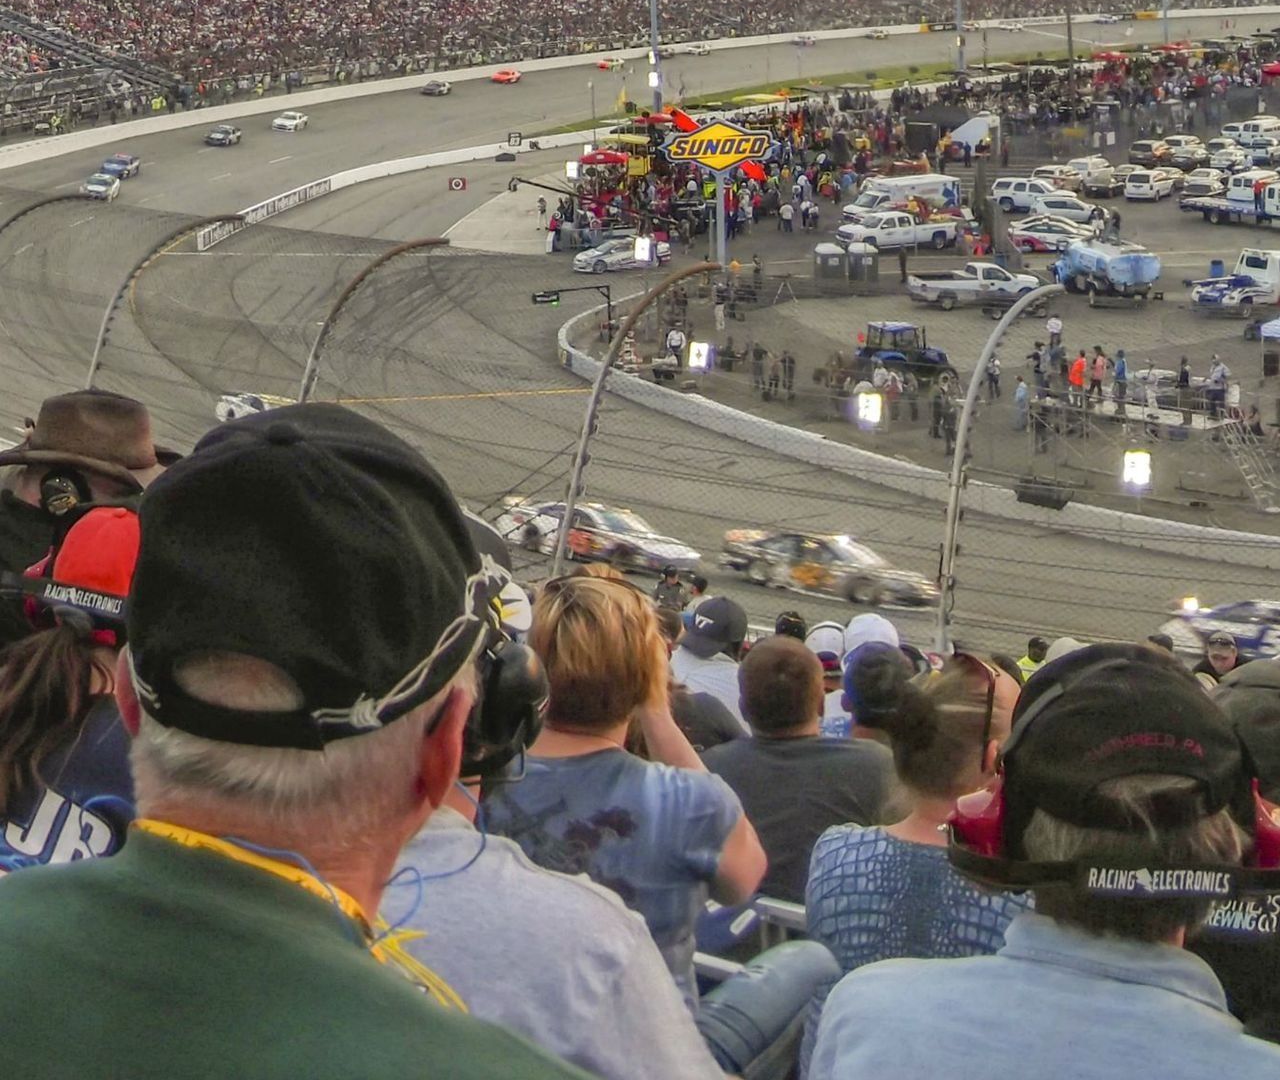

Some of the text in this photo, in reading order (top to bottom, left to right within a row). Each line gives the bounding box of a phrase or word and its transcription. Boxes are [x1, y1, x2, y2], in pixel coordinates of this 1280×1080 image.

[673, 137, 766, 156] SUNOCO
[75, 590, 122, 614] ELECTRONICS
[1088, 867, 1231, 893] RACING ELECTRONICS
